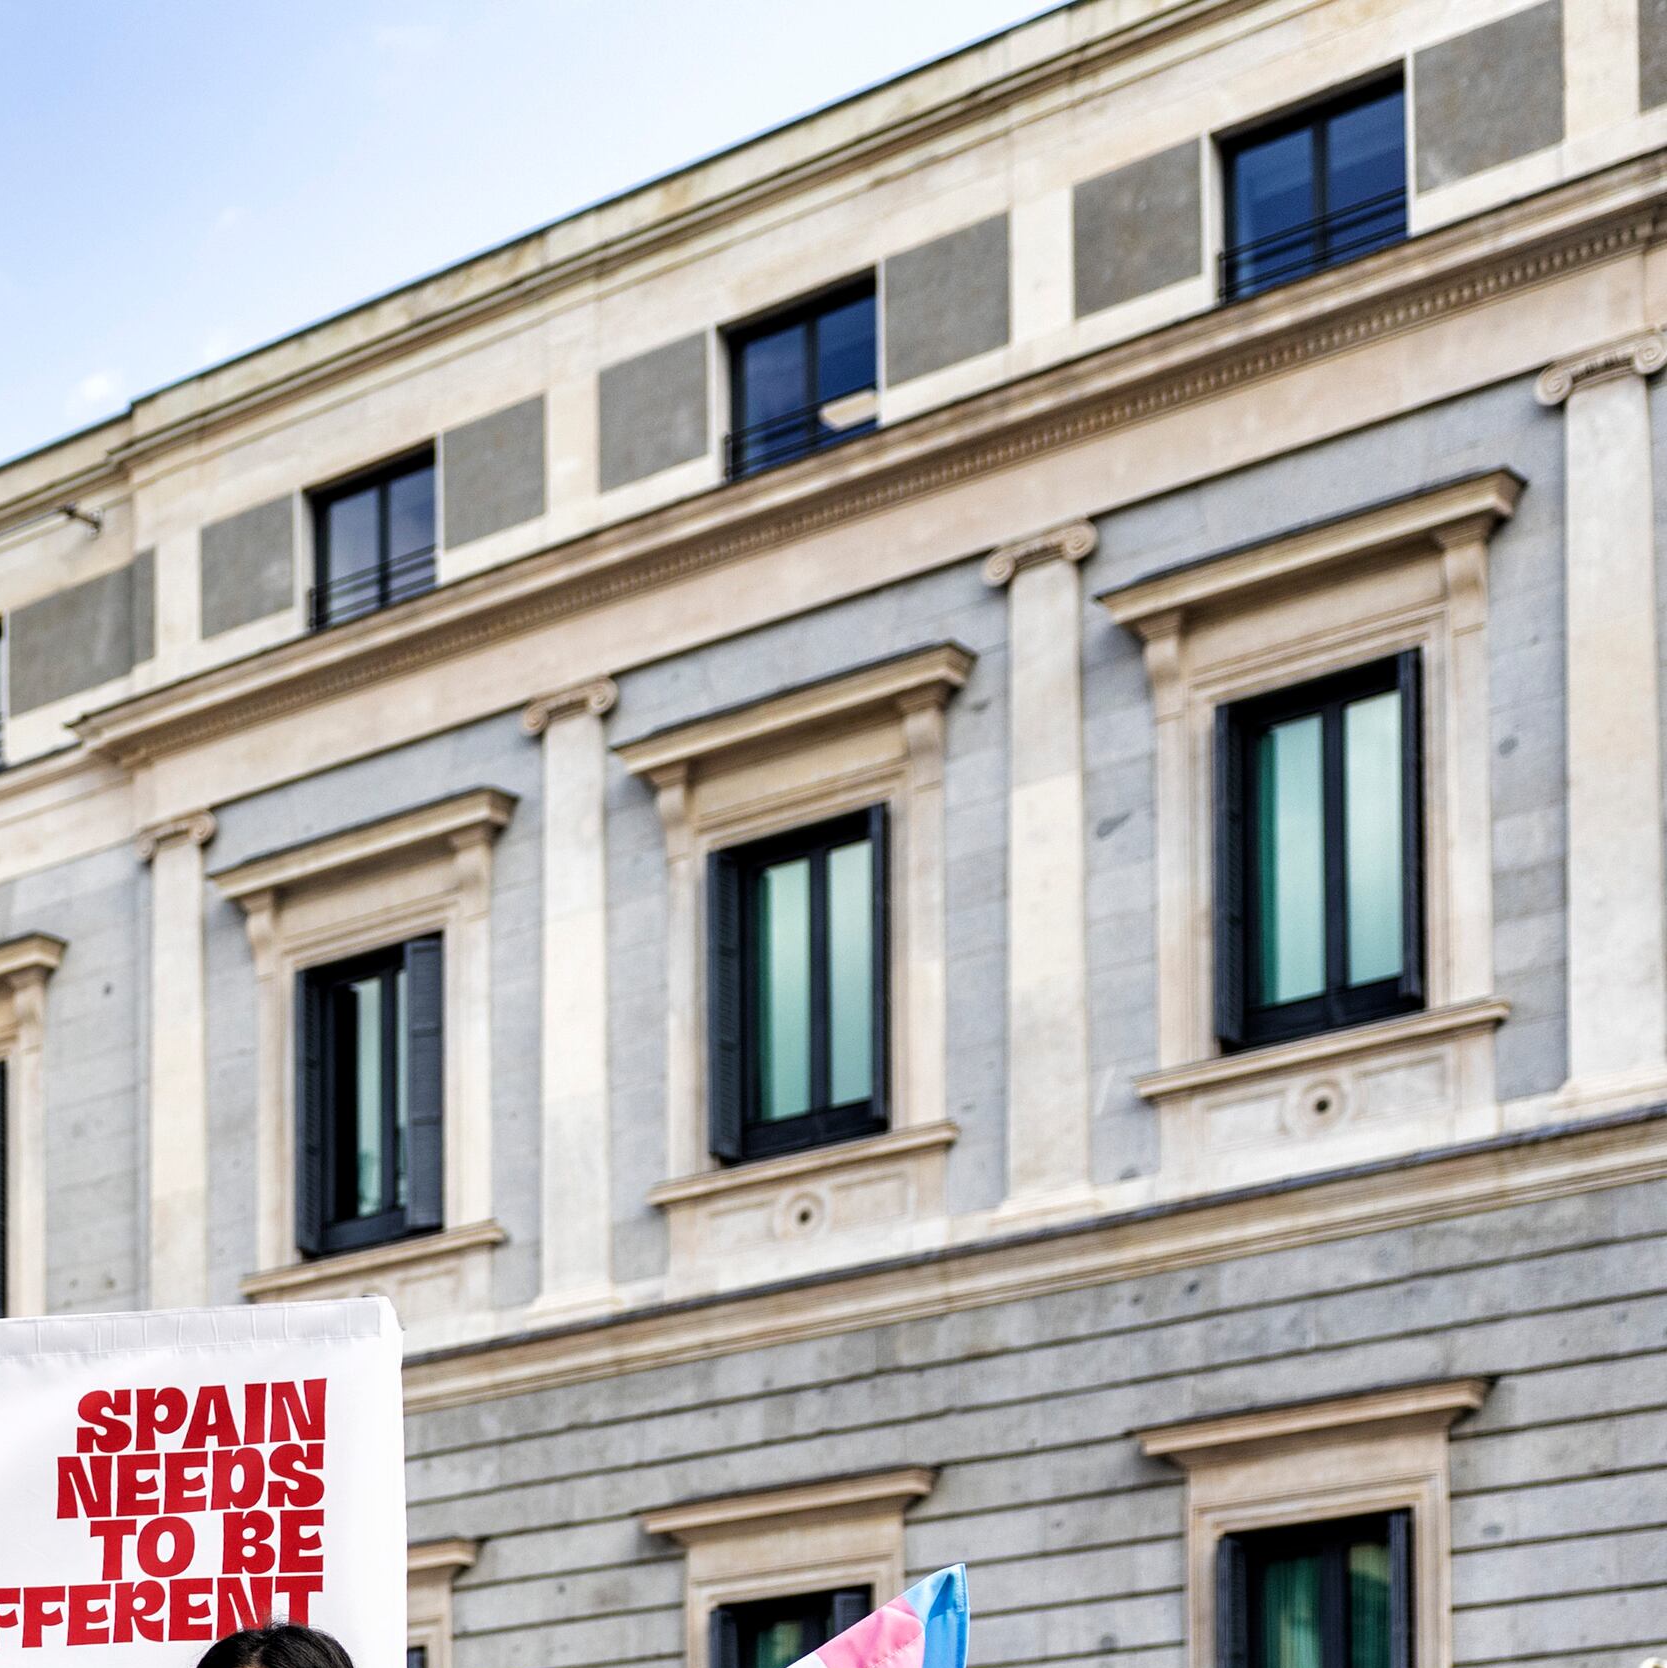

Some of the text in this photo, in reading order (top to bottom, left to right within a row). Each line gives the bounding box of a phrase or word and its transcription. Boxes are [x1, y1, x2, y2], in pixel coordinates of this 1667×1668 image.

[77, 1378, 327, 1453] SPAIN
[56, 1443, 325, 1519] NEEDS
[90, 1509, 325, 1581] TO BE
